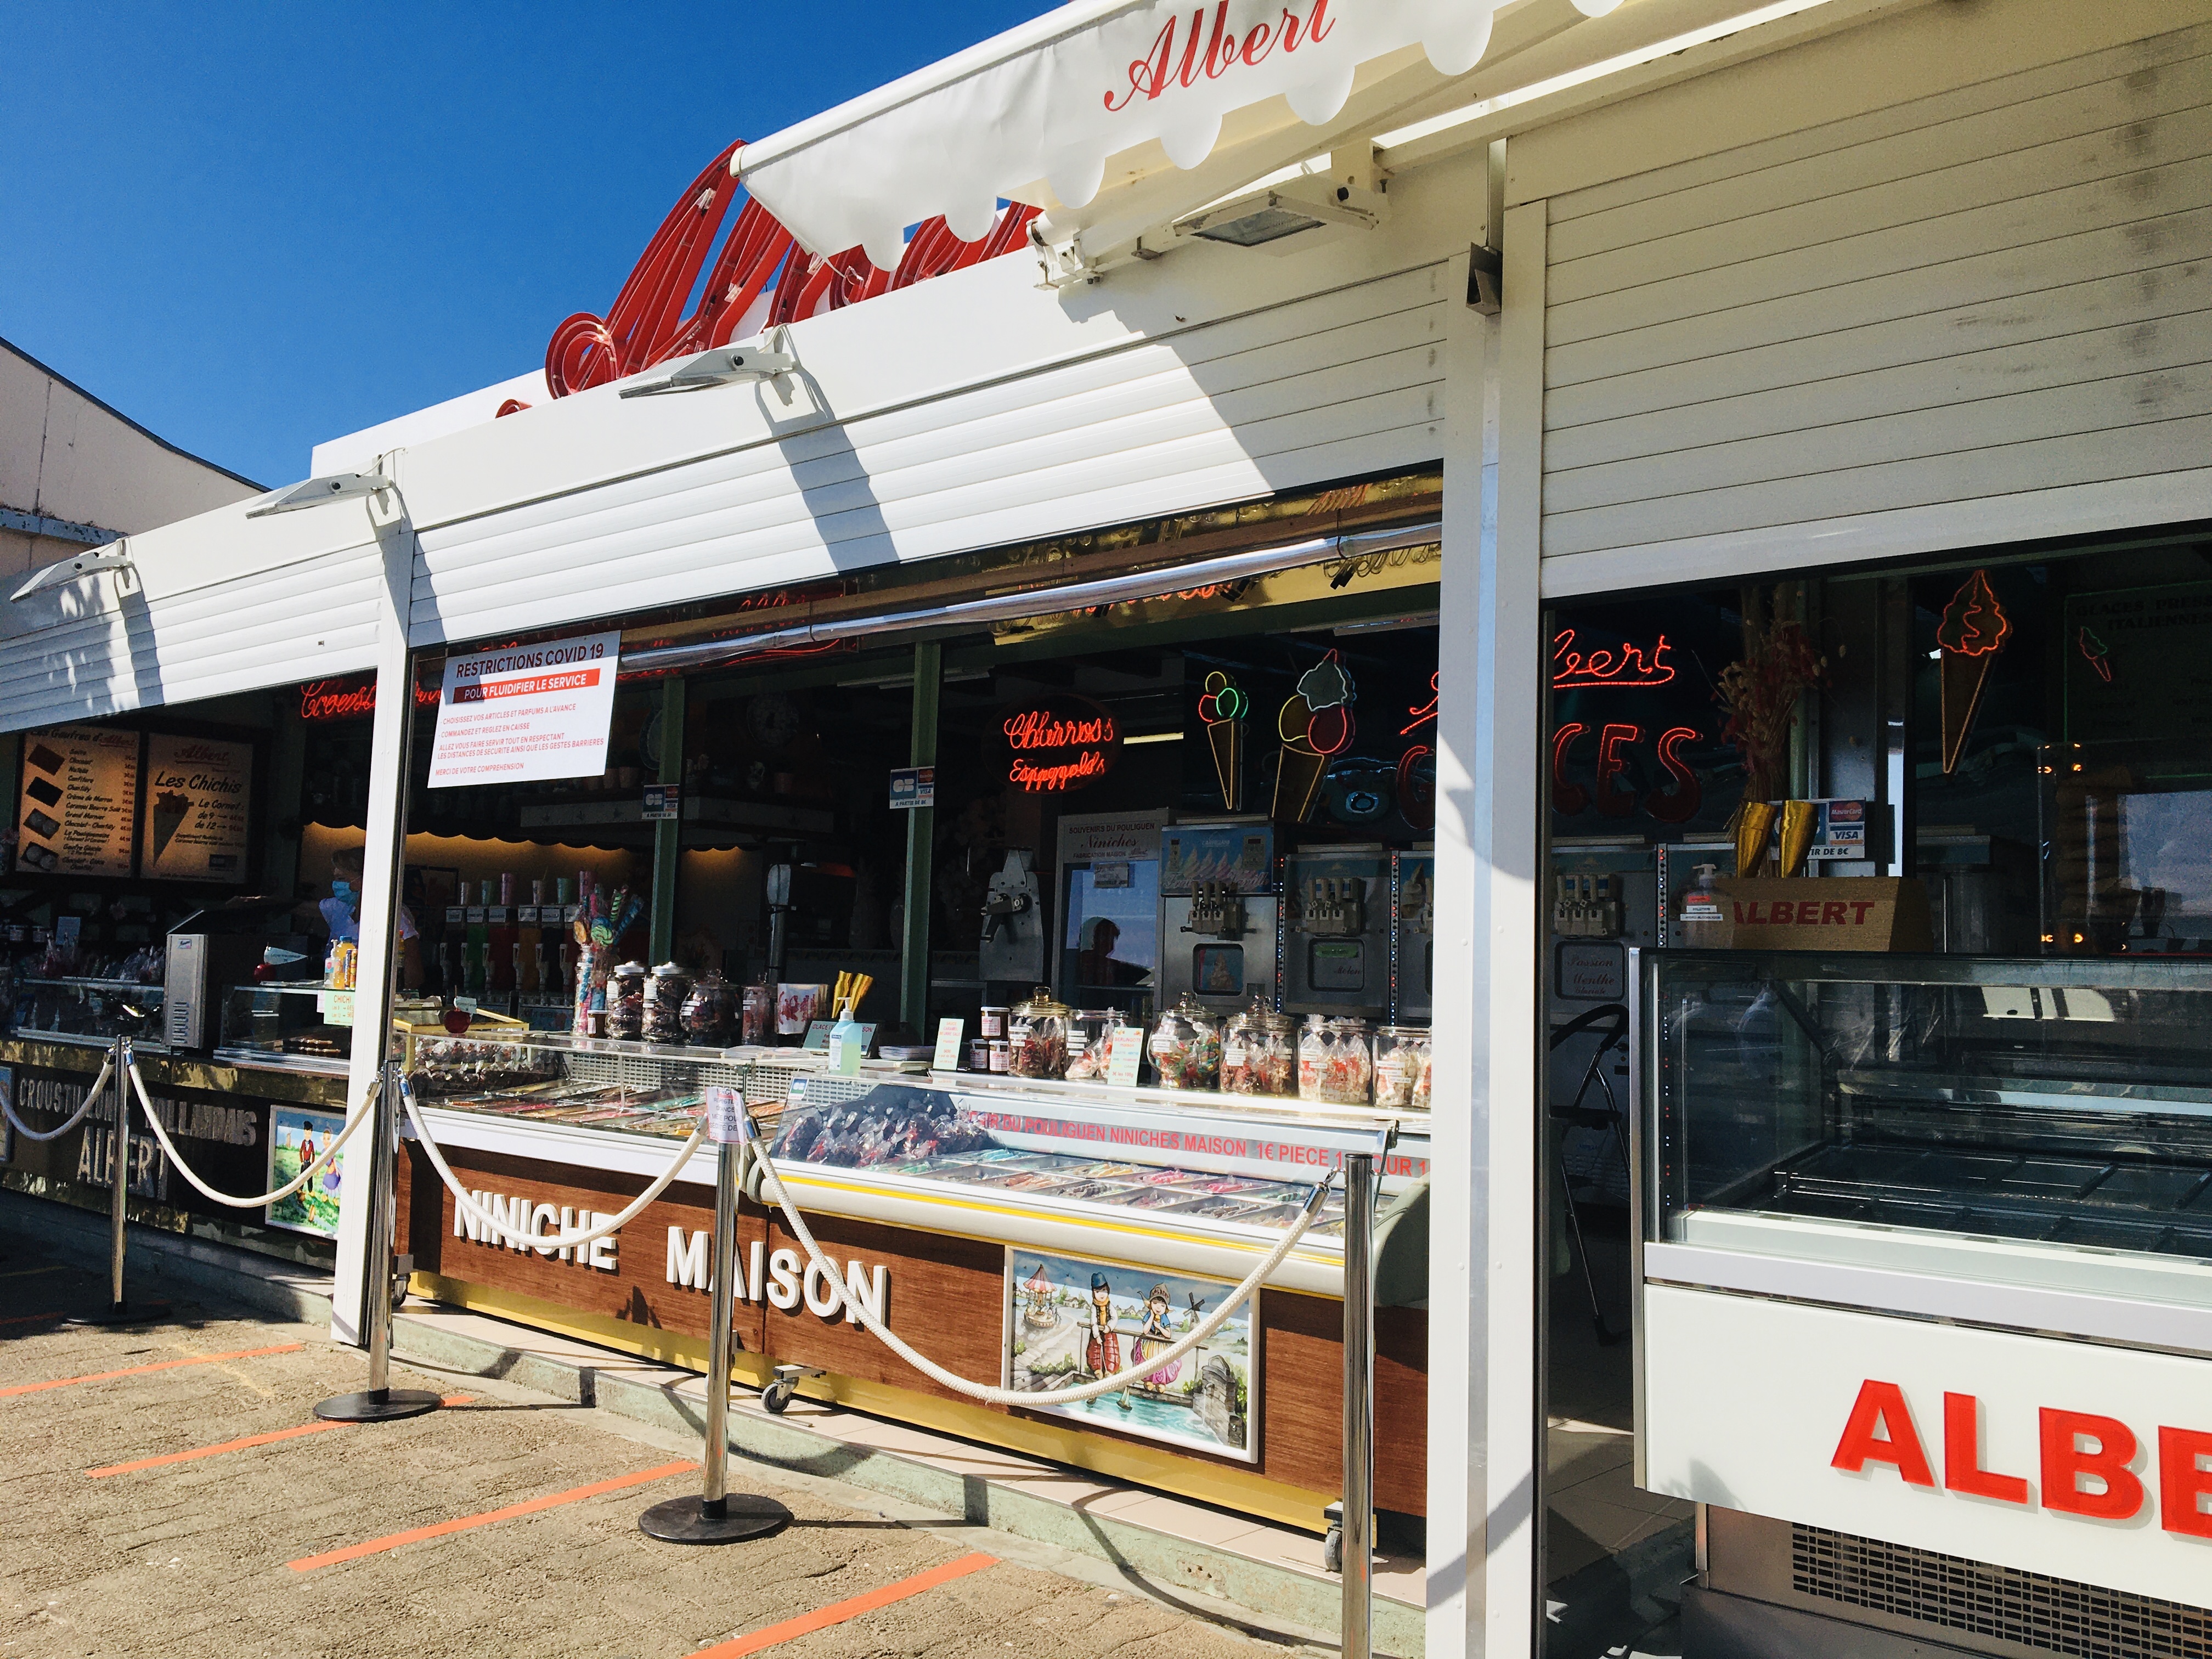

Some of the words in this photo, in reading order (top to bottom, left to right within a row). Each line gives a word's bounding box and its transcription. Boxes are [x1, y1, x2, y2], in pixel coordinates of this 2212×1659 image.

[1104, 0, 1335, 111] Albert
[456, 652, 542, 679] RESTRICTIONS
[546, 646, 586, 665] COVID
[590, 643, 603, 659] 19
[465, 687, 487, 699] POUR
[489, 681, 534, 696] FLUIDIFIER
[536, 680, 546, 691] LE
[549, 674, 587, 689] SERVICE
[443, 716, 472, 725] CHOISISSEZ
[485, 712, 510, 720] ARTICLES
[518, 708, 543, 716] PARFUMS
[550, 704, 576, 713] L'AVANCE
[441, 728, 474, 738] COMMANDEZ
[482, 725, 501, 733] REGLEZ
[511, 723, 530, 731] CAISSE
[439, 743, 454, 751] ALLEZ
[529, 733, 565, 742] RESPECTANT
[447, 750, 475, 759] DISTANCES
[484, 747, 510, 755] SECURITE
[550, 741, 571, 749] GESTES
[572, 738, 603, 747] BARRIERES
[477, 763, 524, 772] COMPREHENSION
[154, 771, 185, 788] Les
[188, 774, 242, 794] Chichis
[198, 798, 210, 809] Le
[198, 811, 208, 820] de
[195, 820, 205, 829] de
[206, 822, 217, 830] 12
[1069, 825, 1104, 834] SOUVENIRS
[1116, 823, 1155, 832] POULIGUEN
[1081, 833, 1139, 849] Niniches
[1835, 831, 1860, 839] VISA
[1003, 1114, 1020, 1132] DU
[1025, 1116, 1105, 1141] POULIGUEN
[1110, 1125, 1180, 1150] NINICHES
[1185, 1135, 1246, 1157] MAISON
[1257, 1142, 1273, 1160] 1€
[1279, 1148, 1329, 1166] PIECE
[454, 1187, 619, 1271] NINICHE
[665, 1226, 888, 1325] MISON
